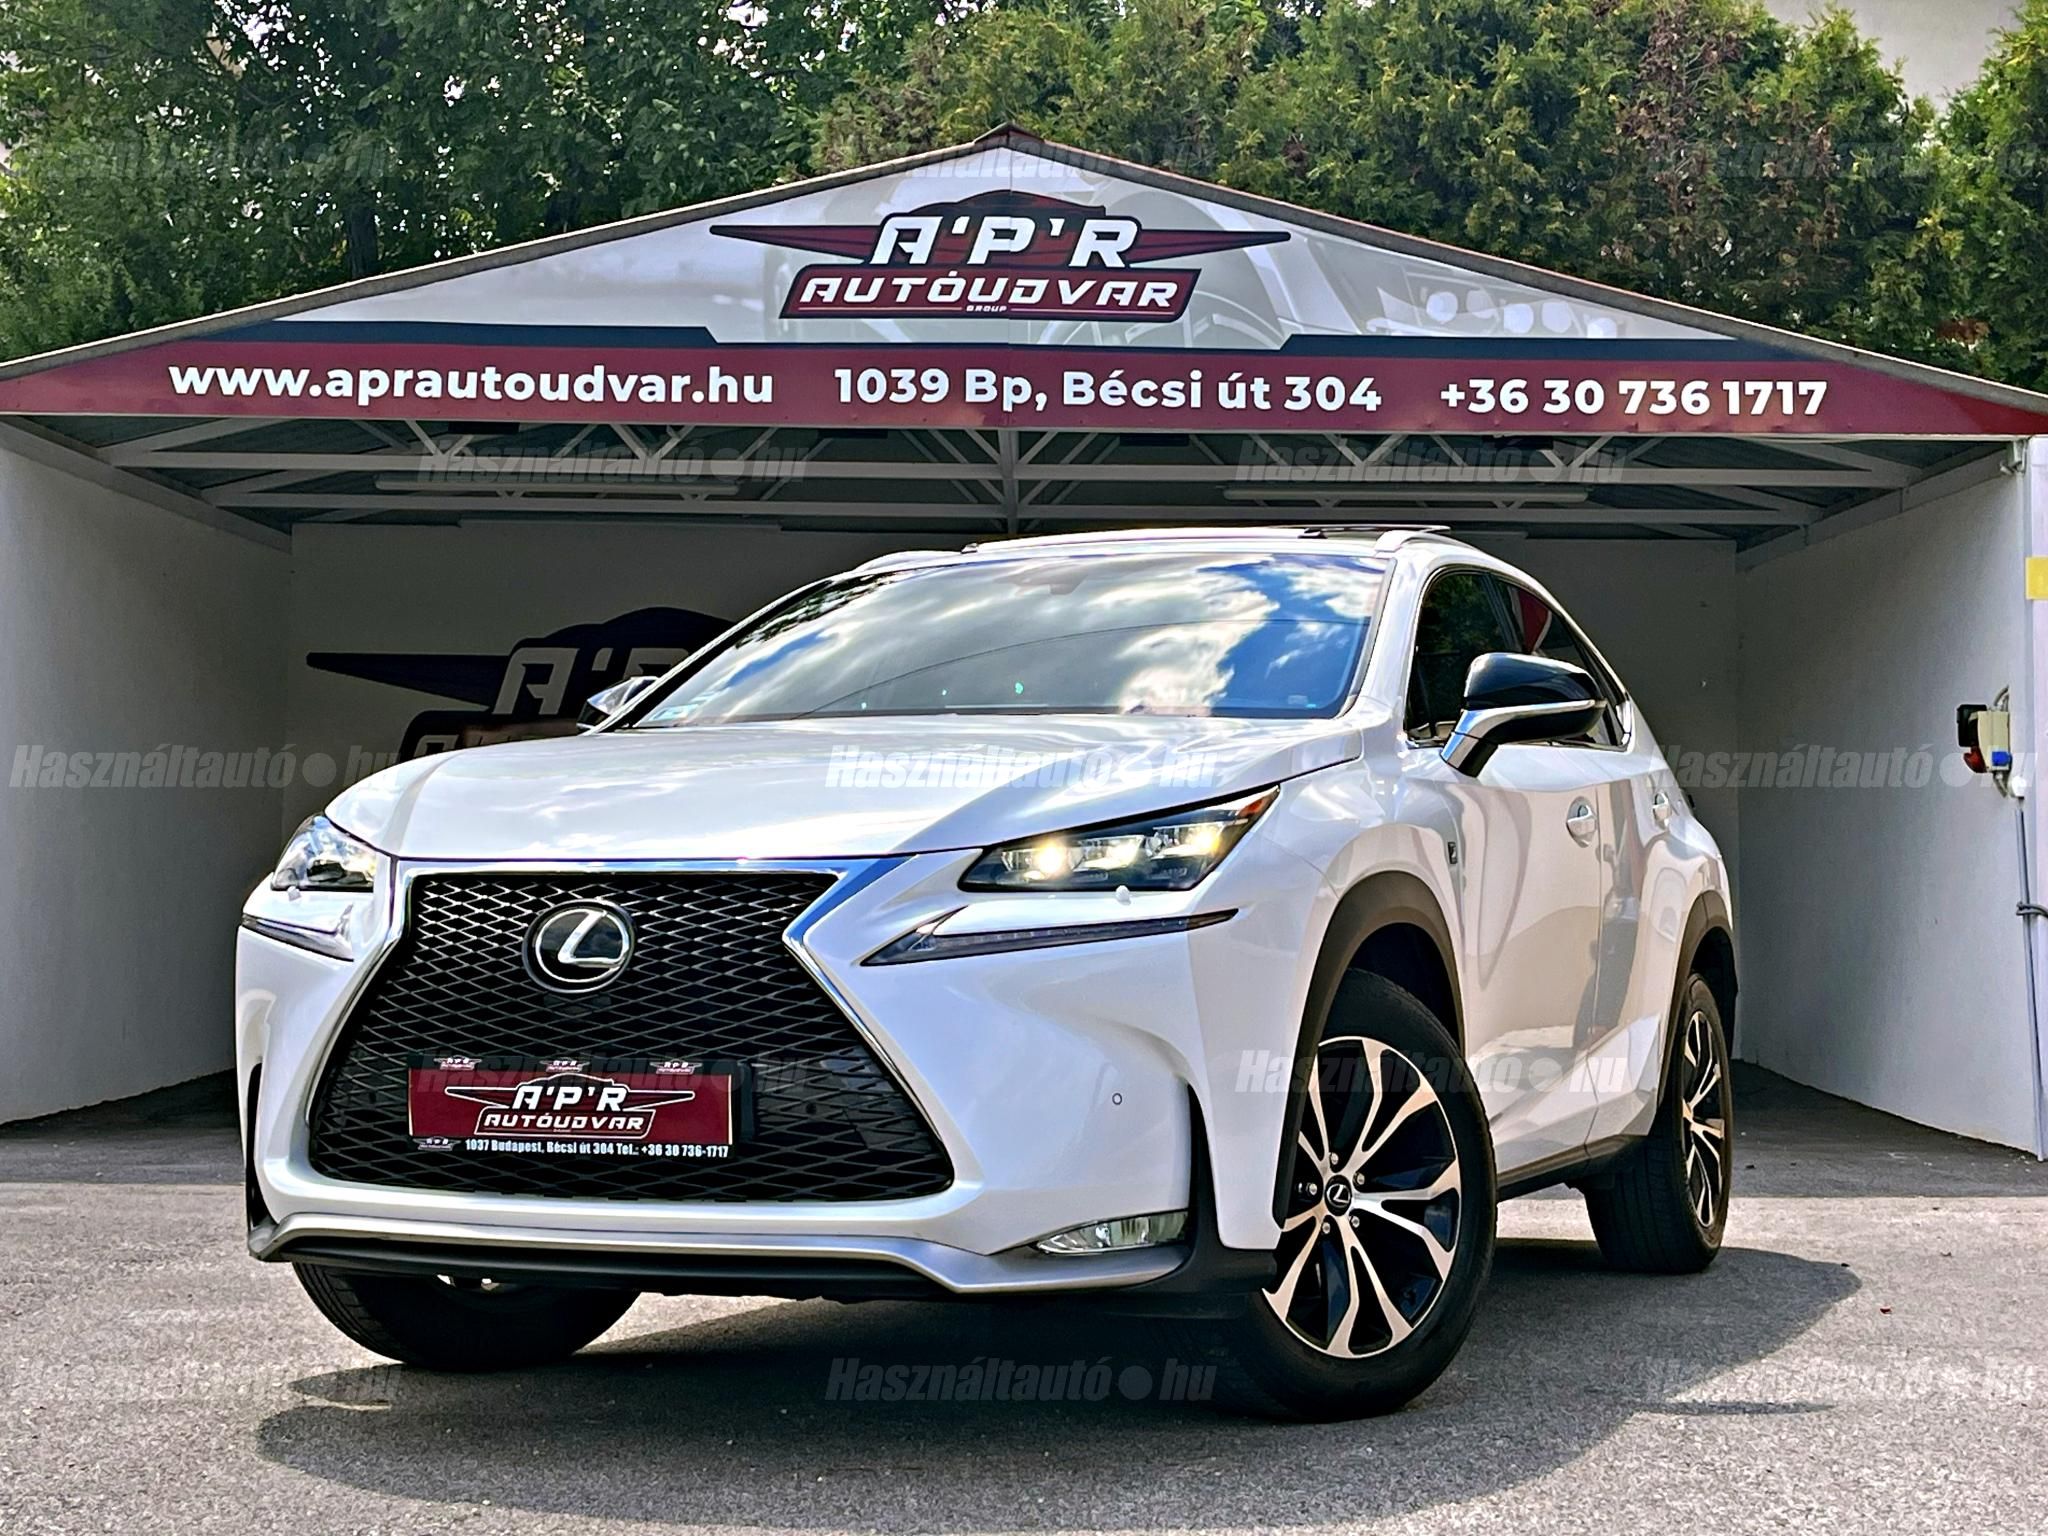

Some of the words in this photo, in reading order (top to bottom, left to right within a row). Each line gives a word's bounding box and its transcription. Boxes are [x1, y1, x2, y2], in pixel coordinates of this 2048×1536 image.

[800, 271, 1178, 308] AUTÓUDVAR
[168, 364, 774, 406] www.aprautoudvar.hu
[834, 367, 950, 404] 1039
[964, 368, 1048, 412] Bp,
[1062, 368, 1202, 409] Bécsi
[1217, 371, 1272, 410] út
[1283, 375, 1382, 412] 304
[1440, 377, 1529, 414] +36
[1543, 378, 1605, 414] 30
[1617, 379, 1711, 416] 736
[1721, 380, 1828, 416] 1717
[484, 1112, 644, 1130] AUTÓUDVAR
[465, 1138, 490, 1151] 1037
[593, 1142, 615, 1155] 304
[641, 1144, 663, 1156] +36
[665, 1144, 680, 1157] 30
[681, 1145, 729, 1158] 736-1717
